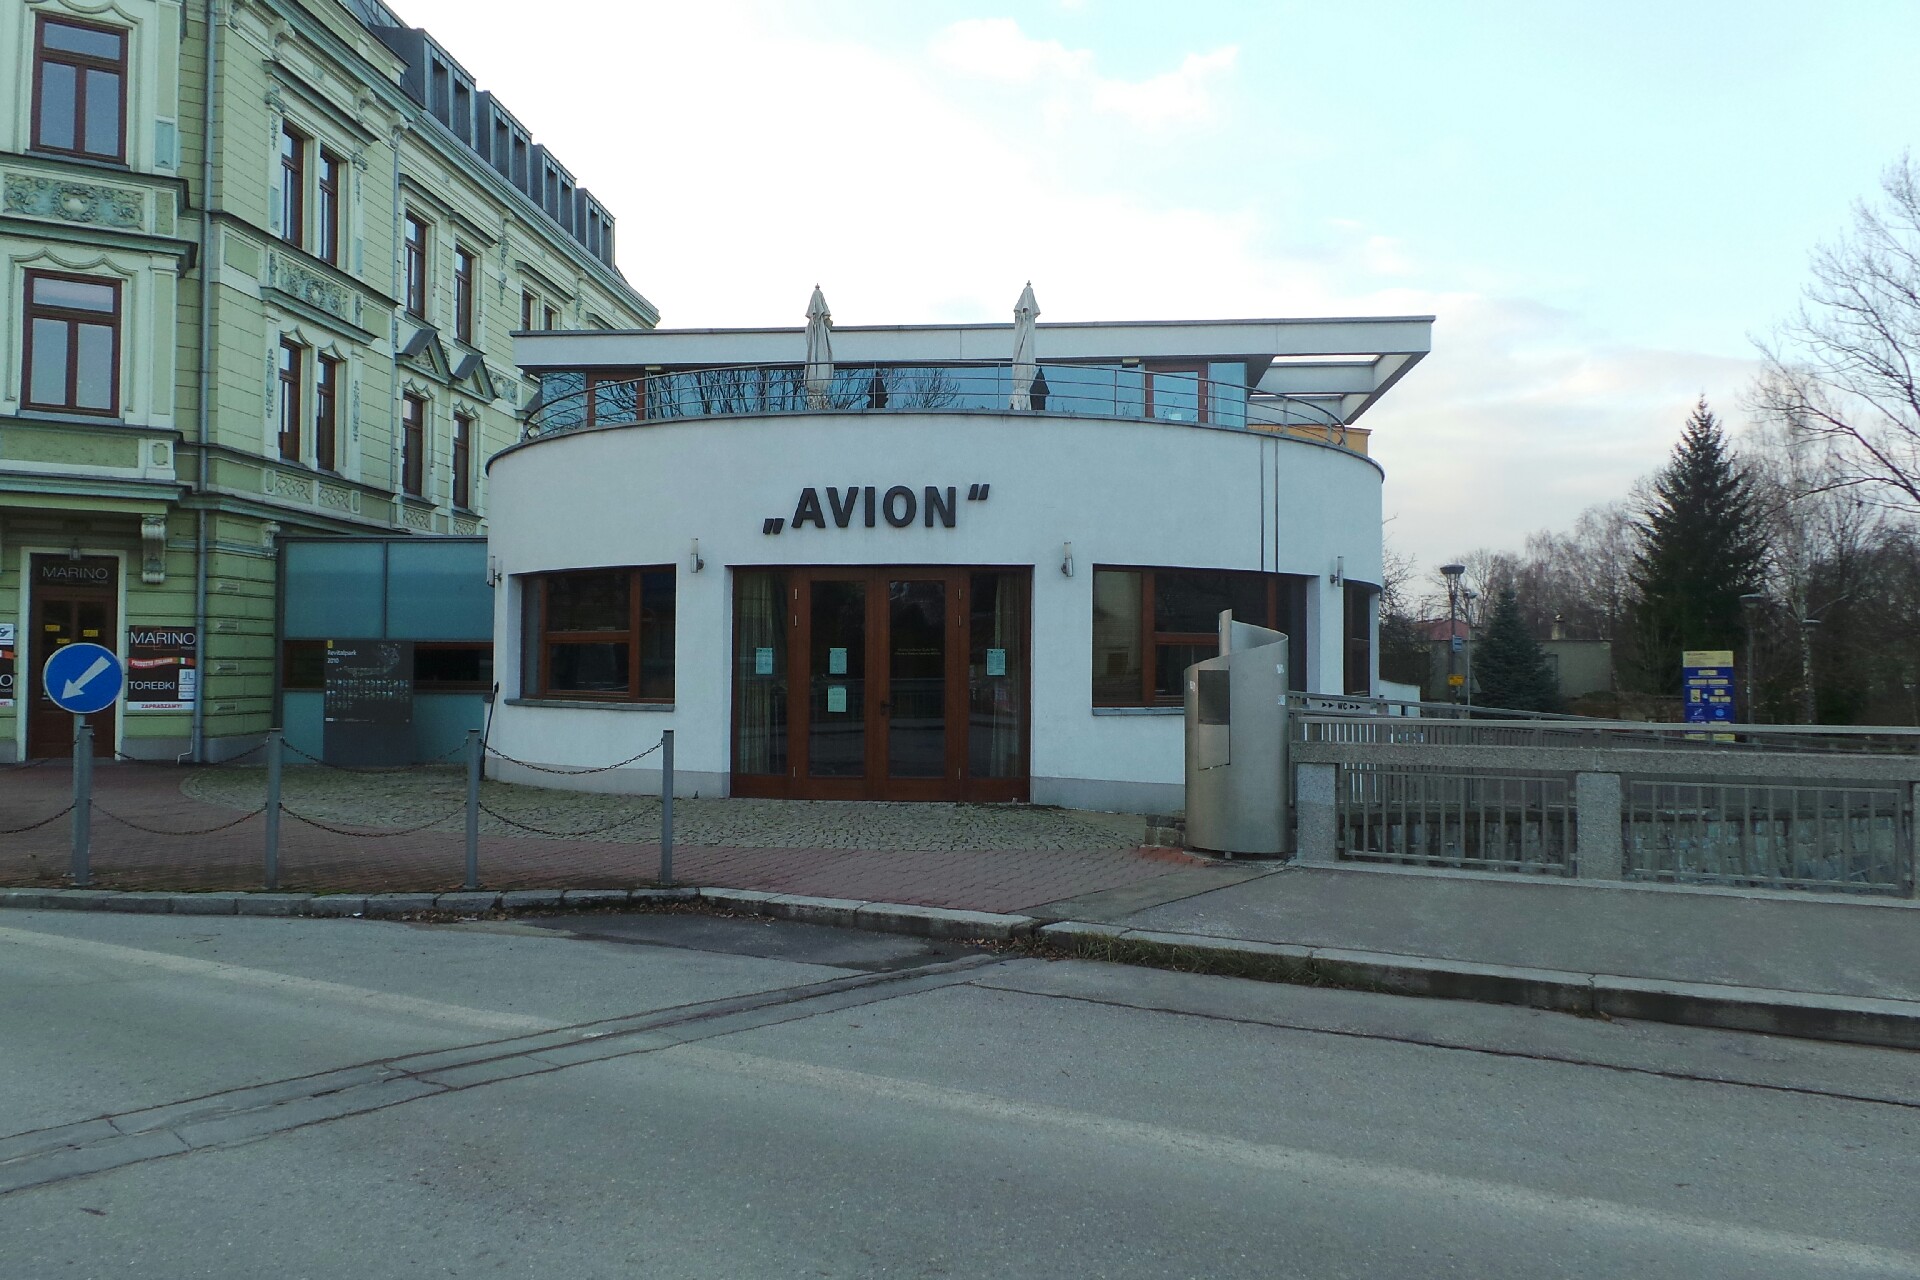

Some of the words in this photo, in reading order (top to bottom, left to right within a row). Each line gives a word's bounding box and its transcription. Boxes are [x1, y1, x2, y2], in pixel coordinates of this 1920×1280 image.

[43, 567, 108, 580] MARINO
[130, 631, 196, 645] MARINO
[129, 681, 175, 690] TOREBKI
[1337, 702, 1348, 710] WC
